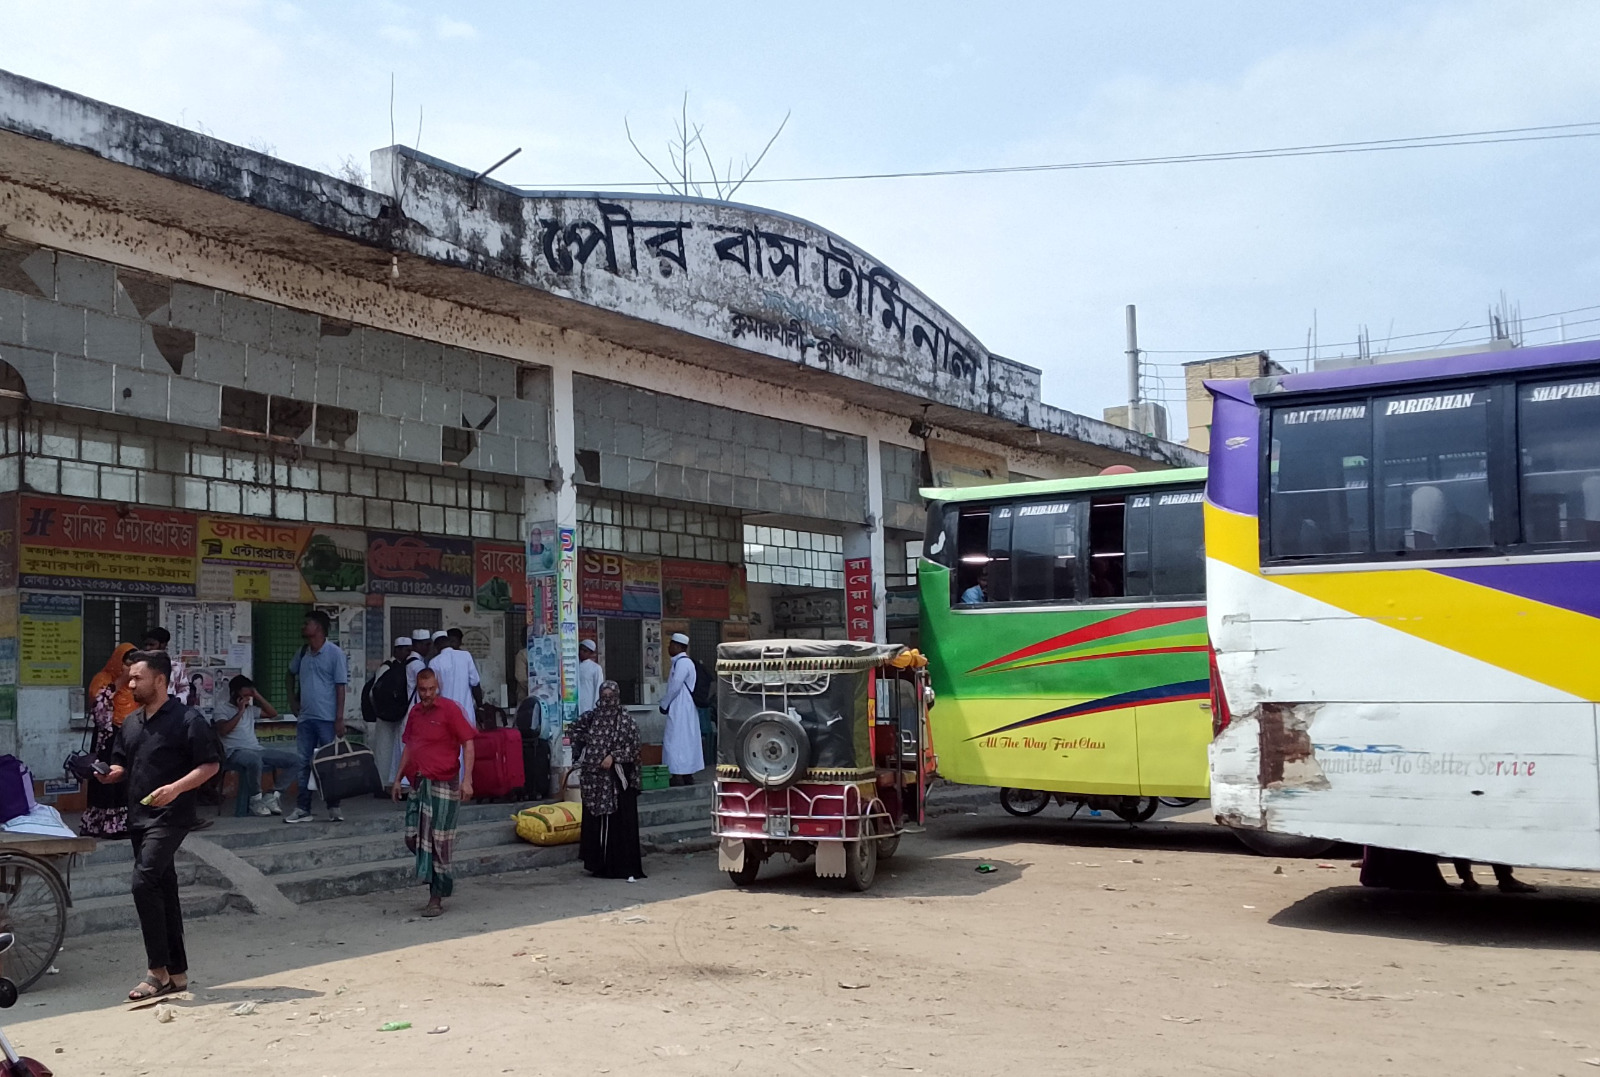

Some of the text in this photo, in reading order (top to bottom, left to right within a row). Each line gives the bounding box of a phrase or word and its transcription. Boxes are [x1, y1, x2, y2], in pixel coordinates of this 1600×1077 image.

[540, 201, 692, 278] পৌর
[706, 223, 806, 286] বাস
[1531, 381, 1600, 402] SHAPTABA
[1386, 392, 1475, 416] PARIBAHAN
[1019, 503, 1071, 516] PARIBAHAN
[1158, 492, 1205, 506] PARIBAH
[62, 504, 194, 551] হানিফ এন্টারপ্রাইজ
[208, 520, 297, 544] জামান
[230, 543, 296, 561] এন্টারপ্রাইজ
[480, 549, 526, 573] রাবেয়
[584, 554, 621, 575] SB
[402, 581, 471, 597] 01820-544270
[979, 736, 1106, 751] All The Way First Class
[1318, 753, 1383, 775] mmitted
[1416, 752, 1470, 776] Better
